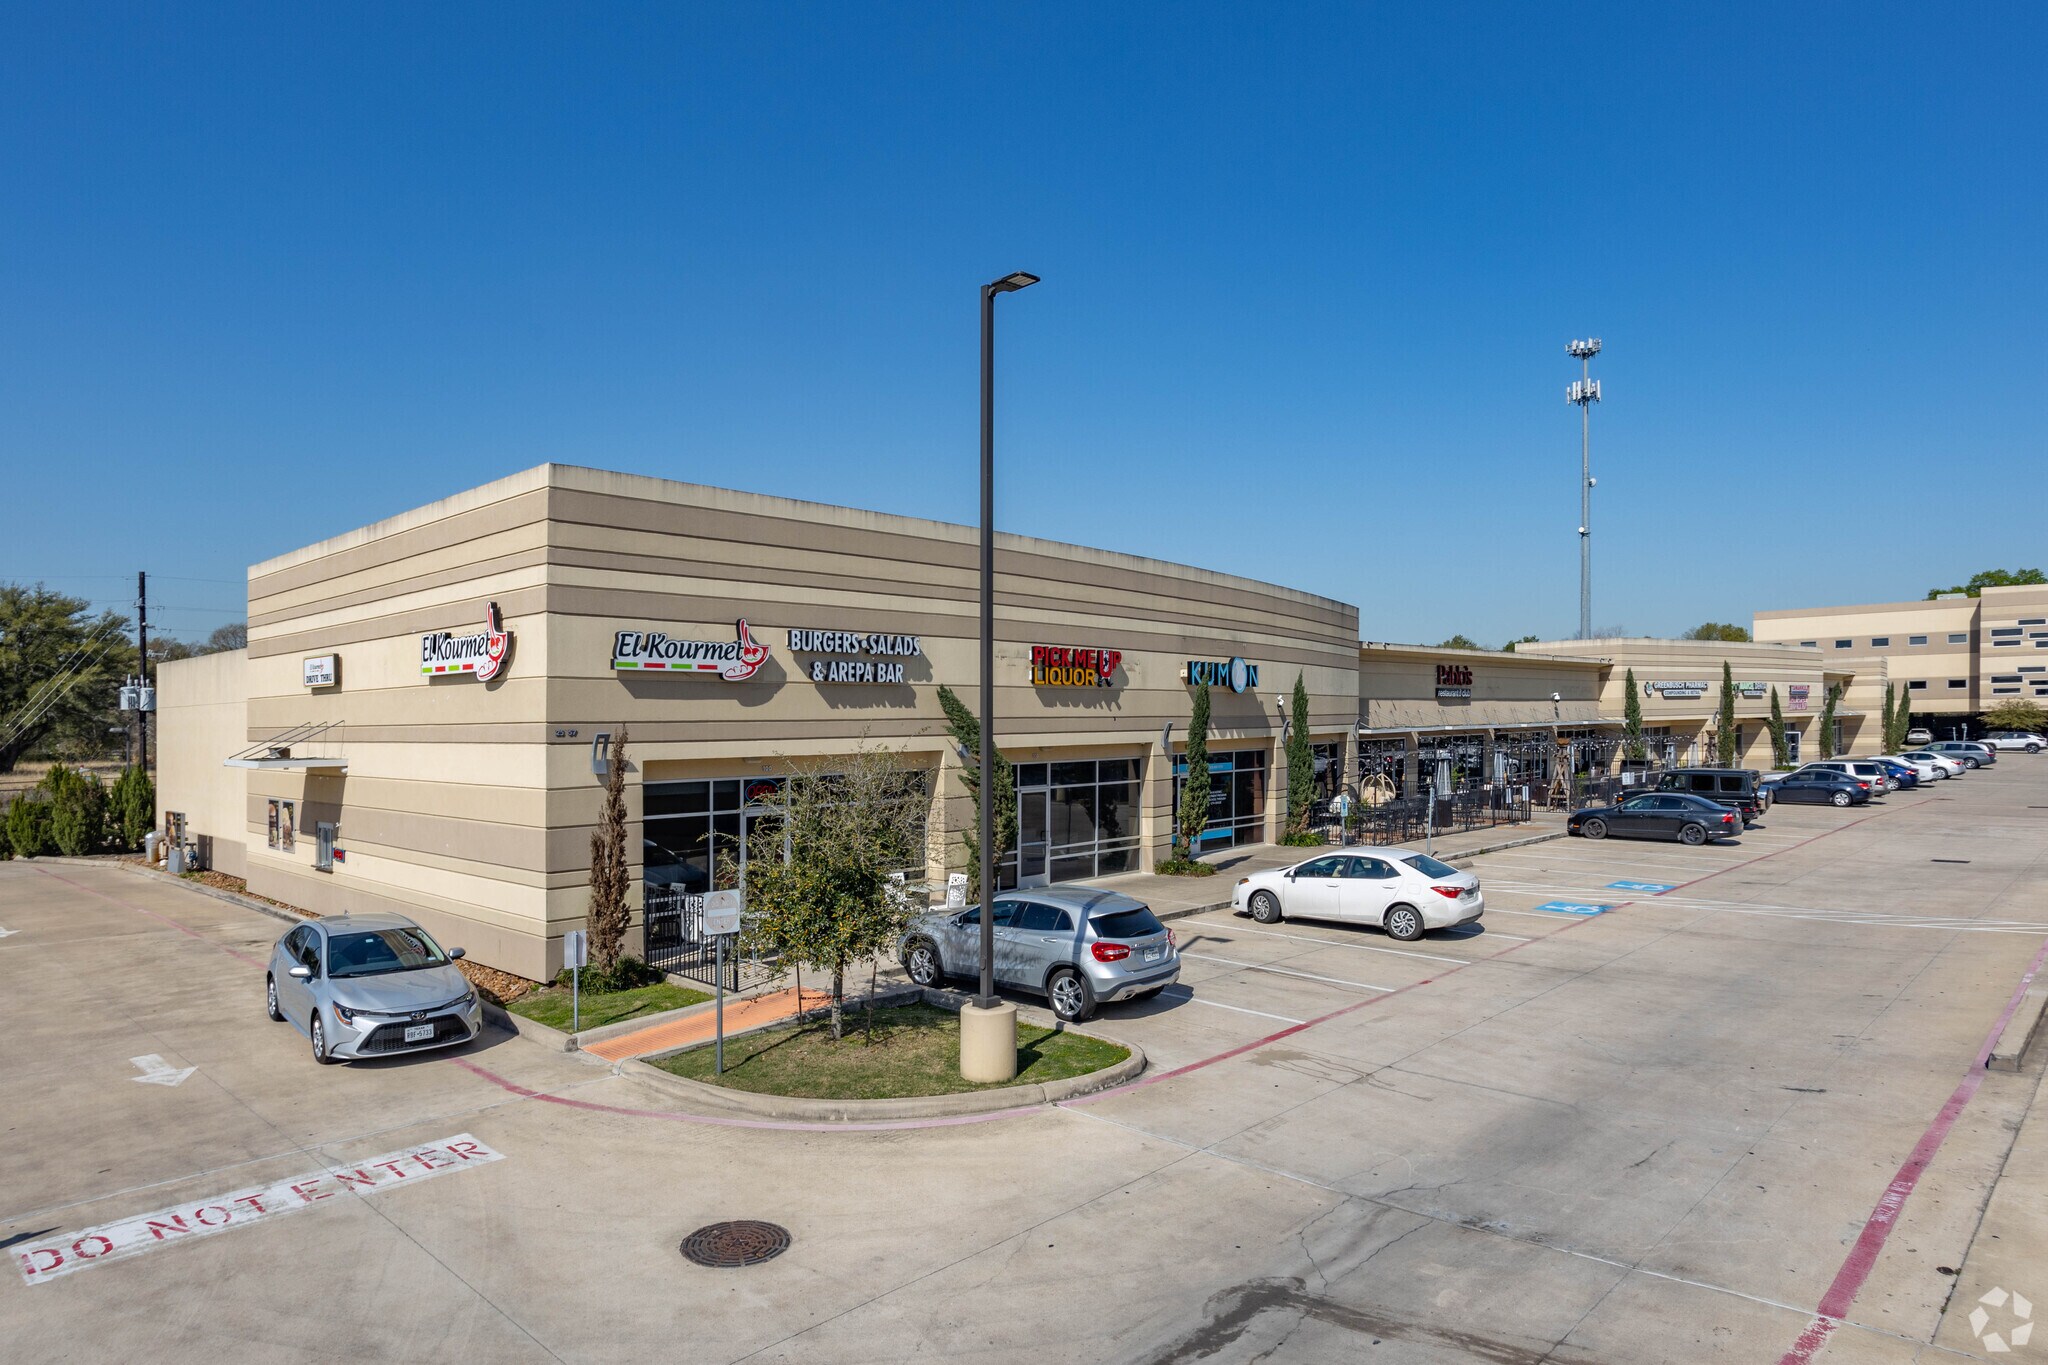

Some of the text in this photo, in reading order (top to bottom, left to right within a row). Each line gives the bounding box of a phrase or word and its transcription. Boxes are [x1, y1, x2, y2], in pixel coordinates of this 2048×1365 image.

[423, 632, 491, 661] El Kourmet
[618, 634, 744, 661] El Kourmet
[791, 630, 920, 655] BURGERS SALADS
[813, 662, 904, 682] & AREPA BAR
[1033, 646, 1122, 678] PICK ME UP
[1191, 656, 1258, 694] KUMON
[1437, 665, 1472, 685] Pablo's
[306, 673, 333, 683] DRIVE THRU
[1034, 667, 1096, 686] LIQUOR
[20, 1141, 489, 1275] DO NOT ENTER
